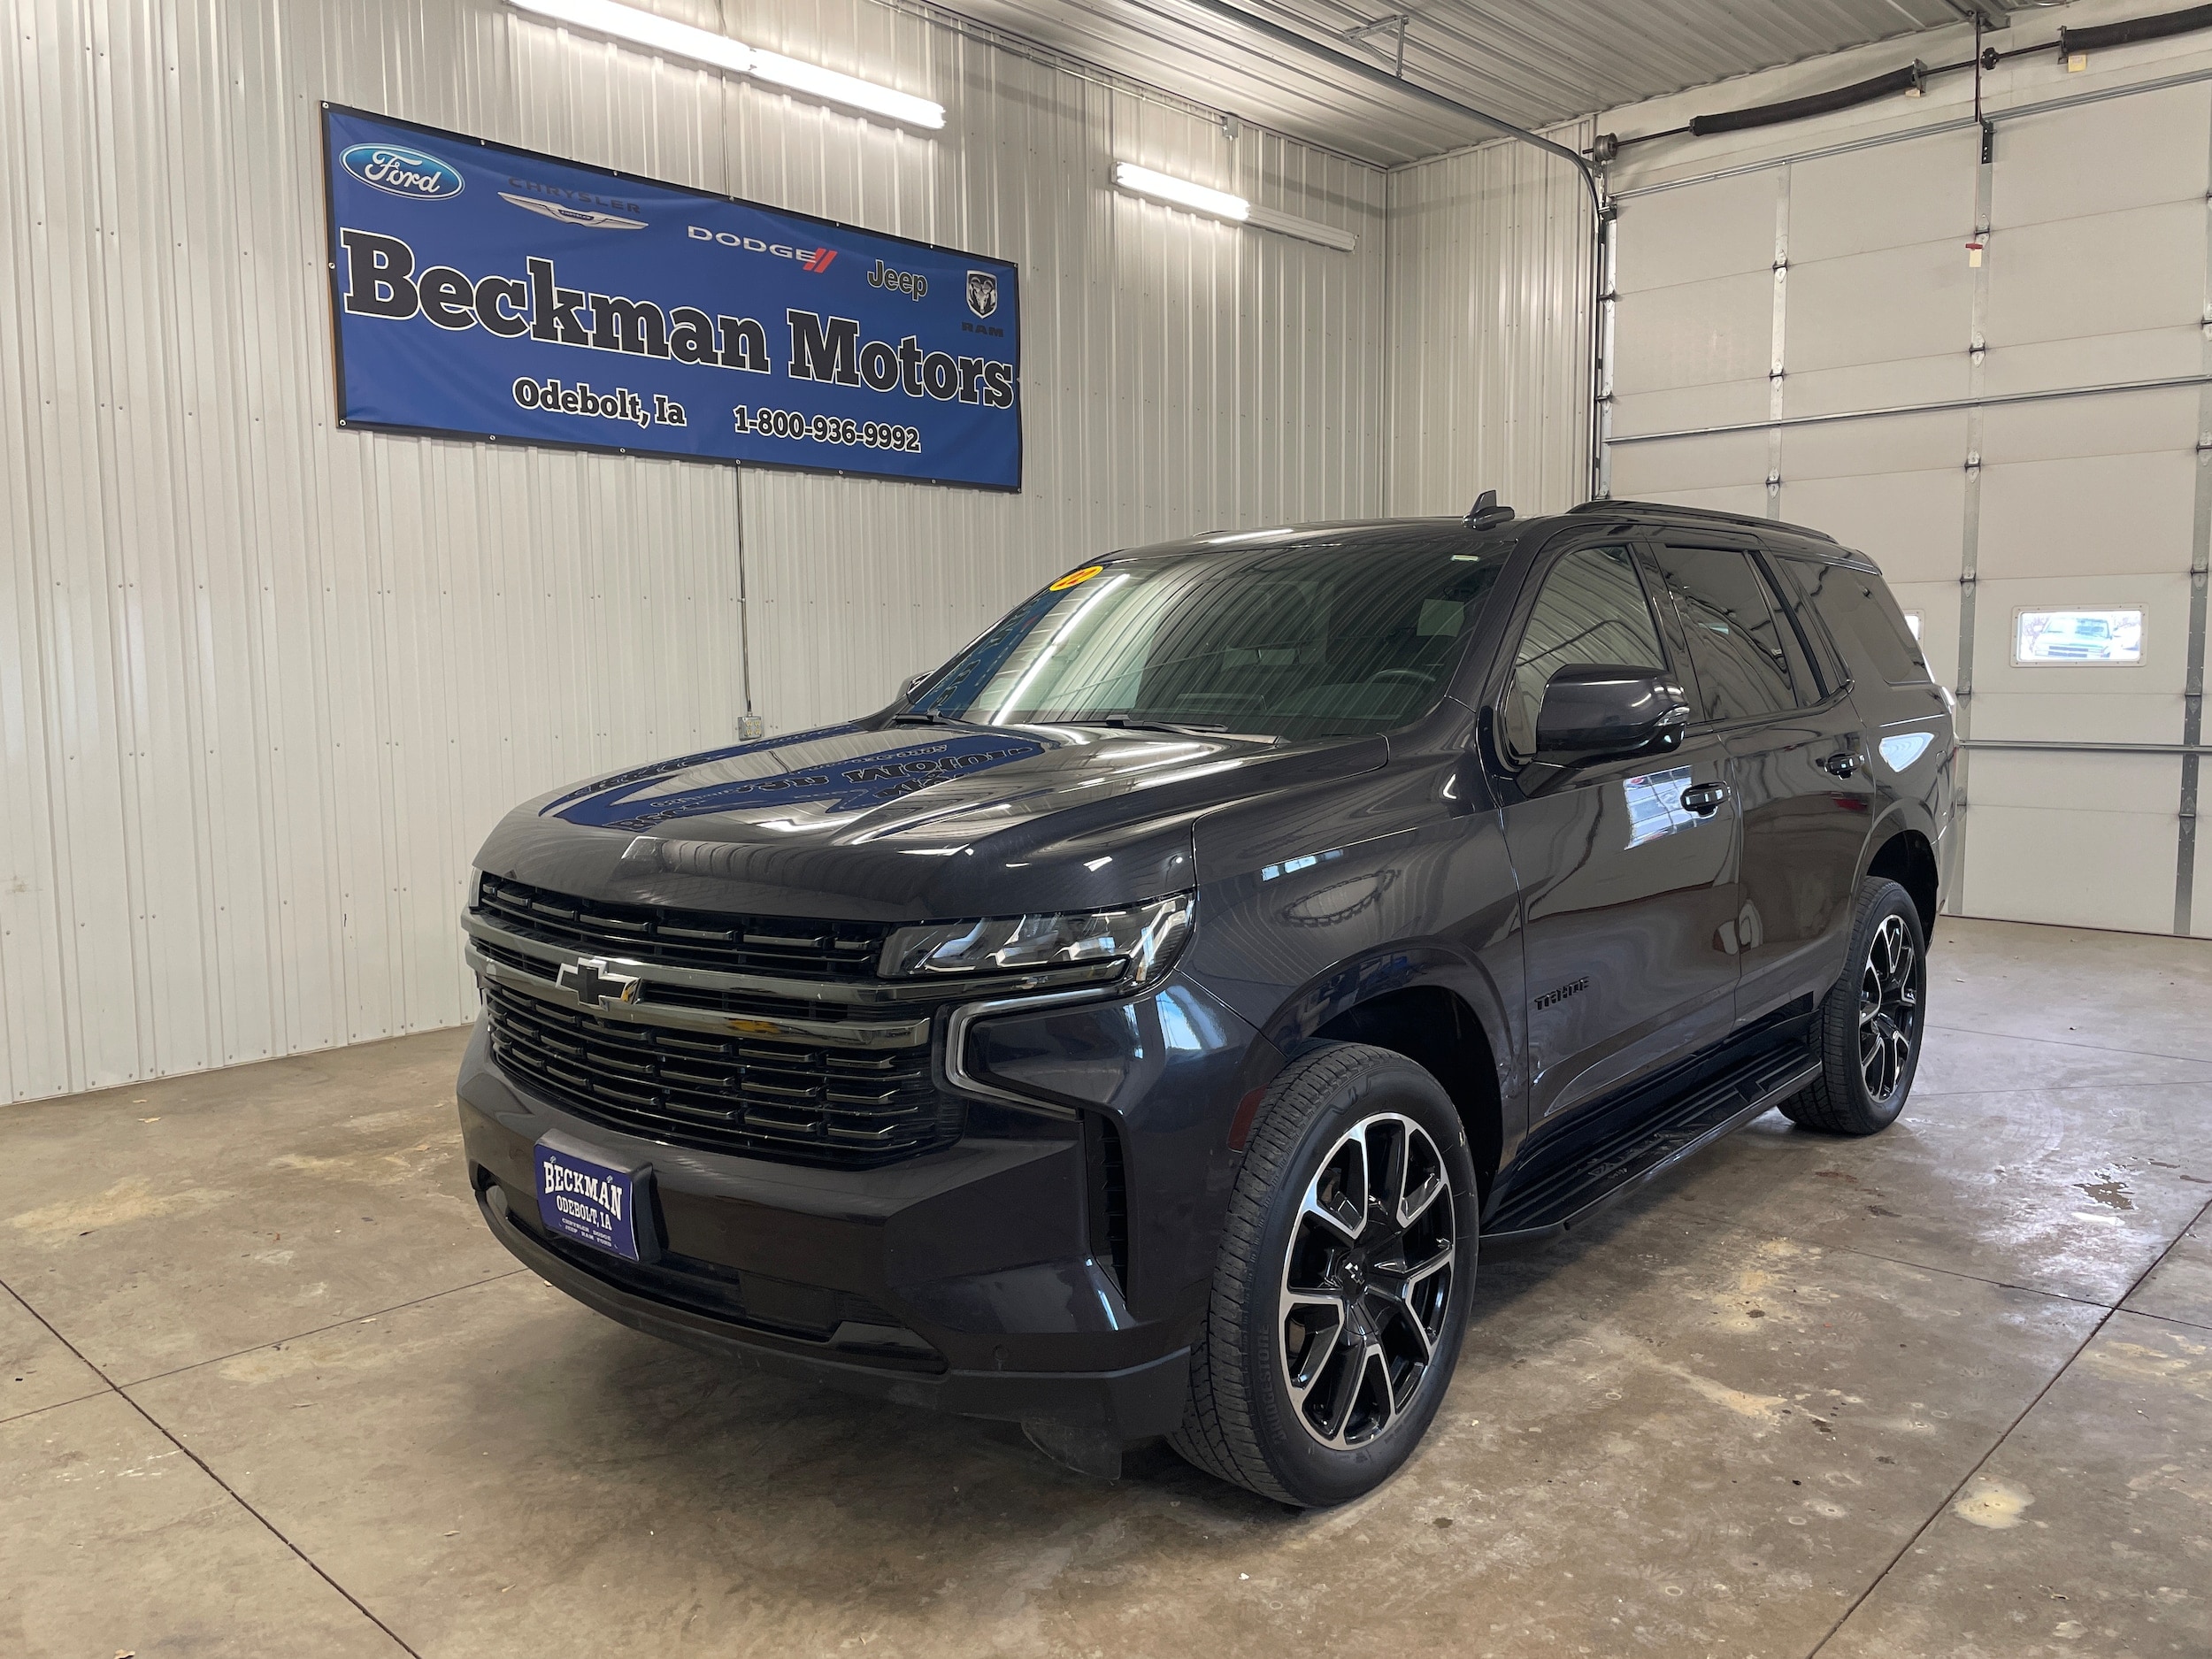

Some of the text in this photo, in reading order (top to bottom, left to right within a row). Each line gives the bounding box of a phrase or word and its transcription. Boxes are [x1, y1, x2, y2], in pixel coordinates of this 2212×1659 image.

[365, 150, 442, 193] Ford
[509, 178, 641, 214] CHRYSLER
[687, 225, 817, 263] DODGE
[867, 260, 928, 301] Jeep
[340, 227, 1014, 409] Beckman Motors
[962, 322, 1003, 337] RAM
[512, 376, 687, 429] Odebolt, Ia
[733, 404, 921, 452] 1-800-936-9992
[543, 1161, 622, 1221] BECKMAN
[556, 1194, 612, 1231] ODEBOLT, IA
